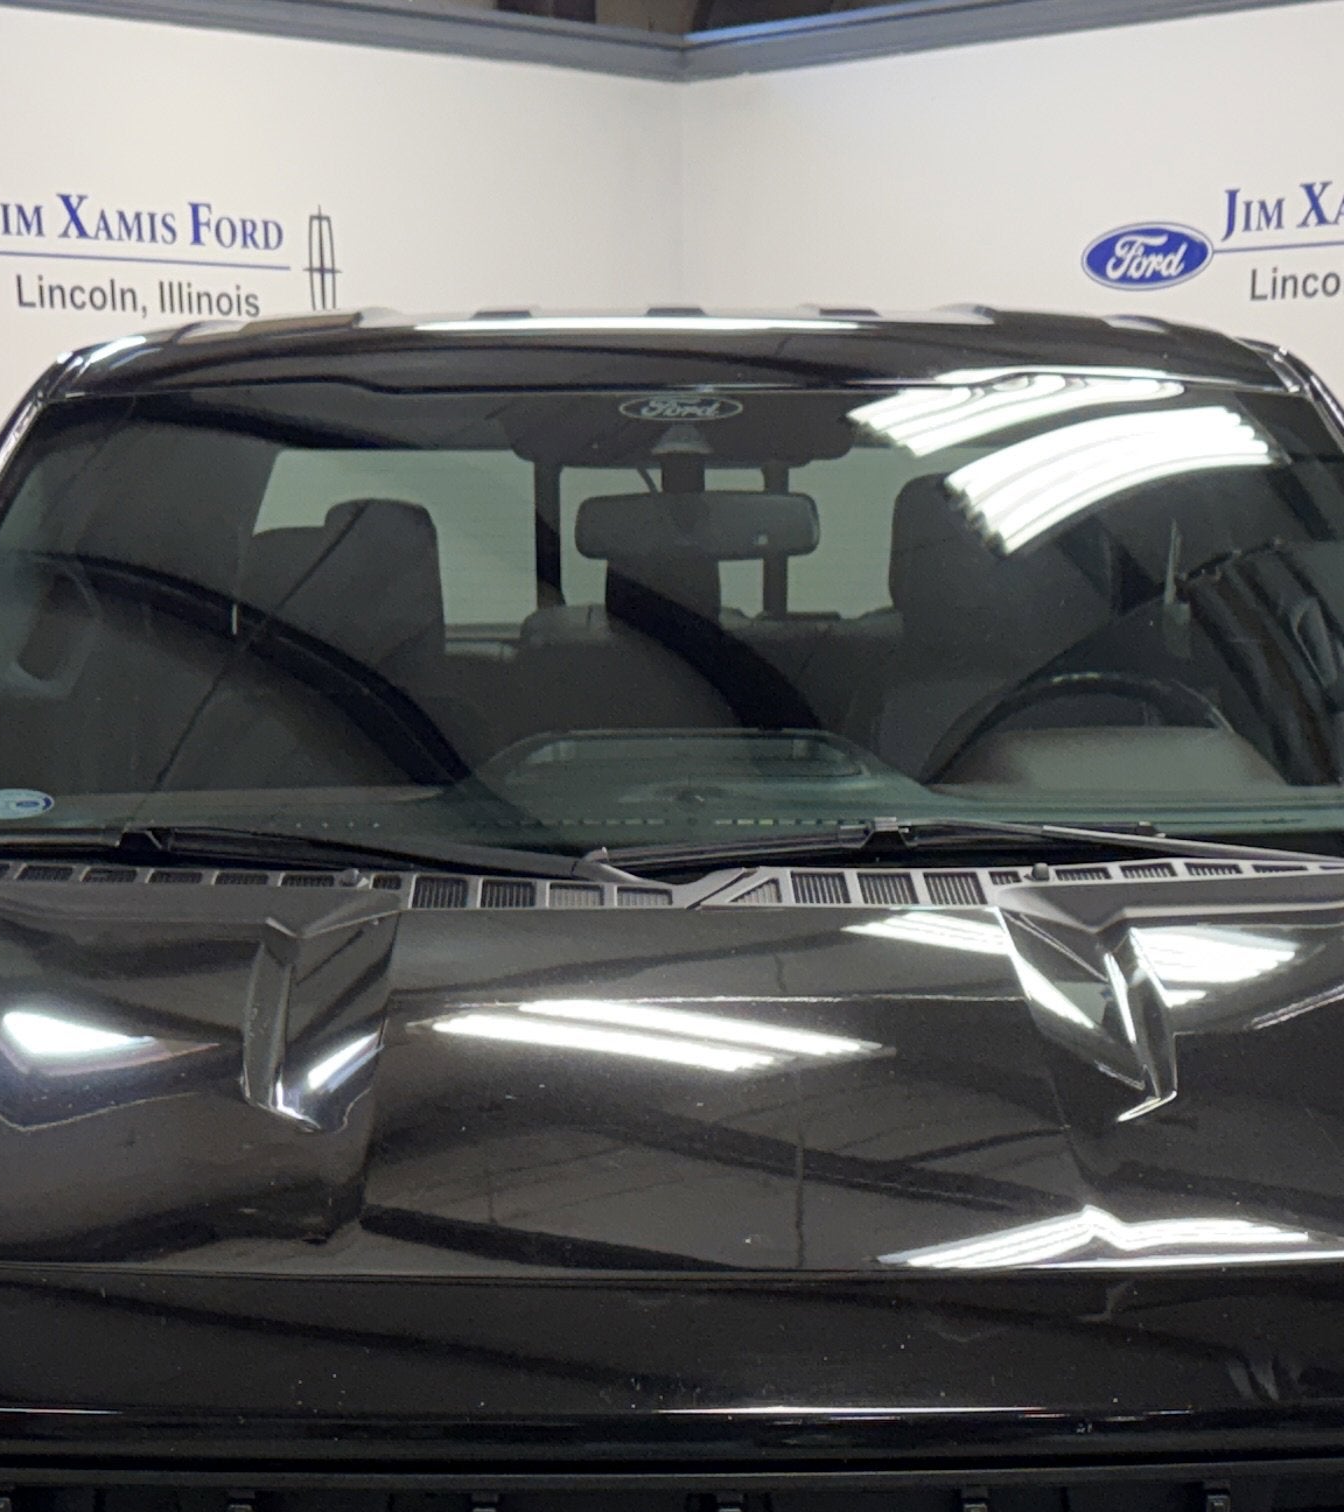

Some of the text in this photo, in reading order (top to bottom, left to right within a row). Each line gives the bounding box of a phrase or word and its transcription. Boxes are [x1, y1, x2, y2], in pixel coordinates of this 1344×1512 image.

[56, 193, 177, 246] XAMIS
[187, 202, 284, 251] FORD
[1222, 188, 1285, 241] JIM
[1105, 234, 1185, 279] Ford
[15, 274, 261, 318] Lincoln, Illinois
[641, 396, 722, 417] Ford
